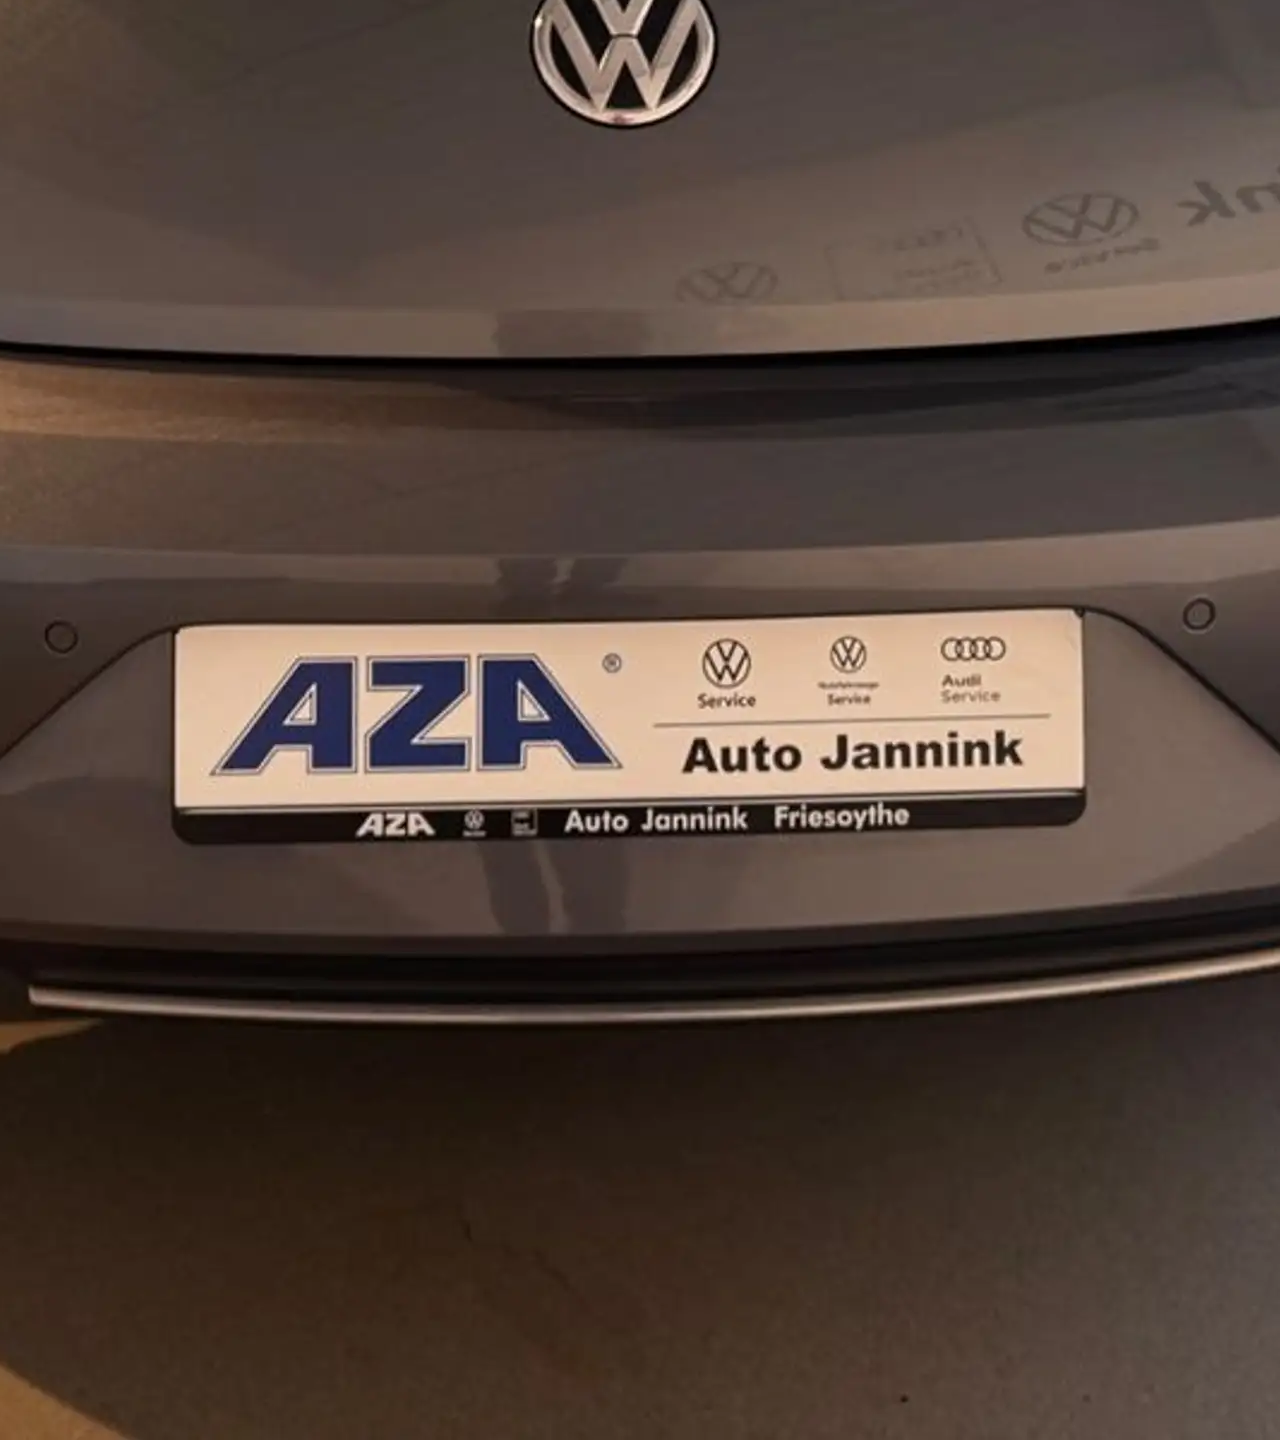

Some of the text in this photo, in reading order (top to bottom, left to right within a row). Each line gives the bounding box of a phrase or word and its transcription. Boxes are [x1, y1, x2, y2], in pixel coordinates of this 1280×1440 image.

[941, 674, 982, 688] Audi
[697, 693, 757, 709] Service
[827, 692, 871, 706] Service
[941, 689, 1001, 703] Service
[210, 654, 623, 776] AZA
[681, 730, 1024, 774] Auto Jannink
[355, 812, 436, 838] AZA
[564, 809, 629, 833] Auto
[640, 805, 749, 832] Jannink
[773, 800, 911, 831] Friesoythe
